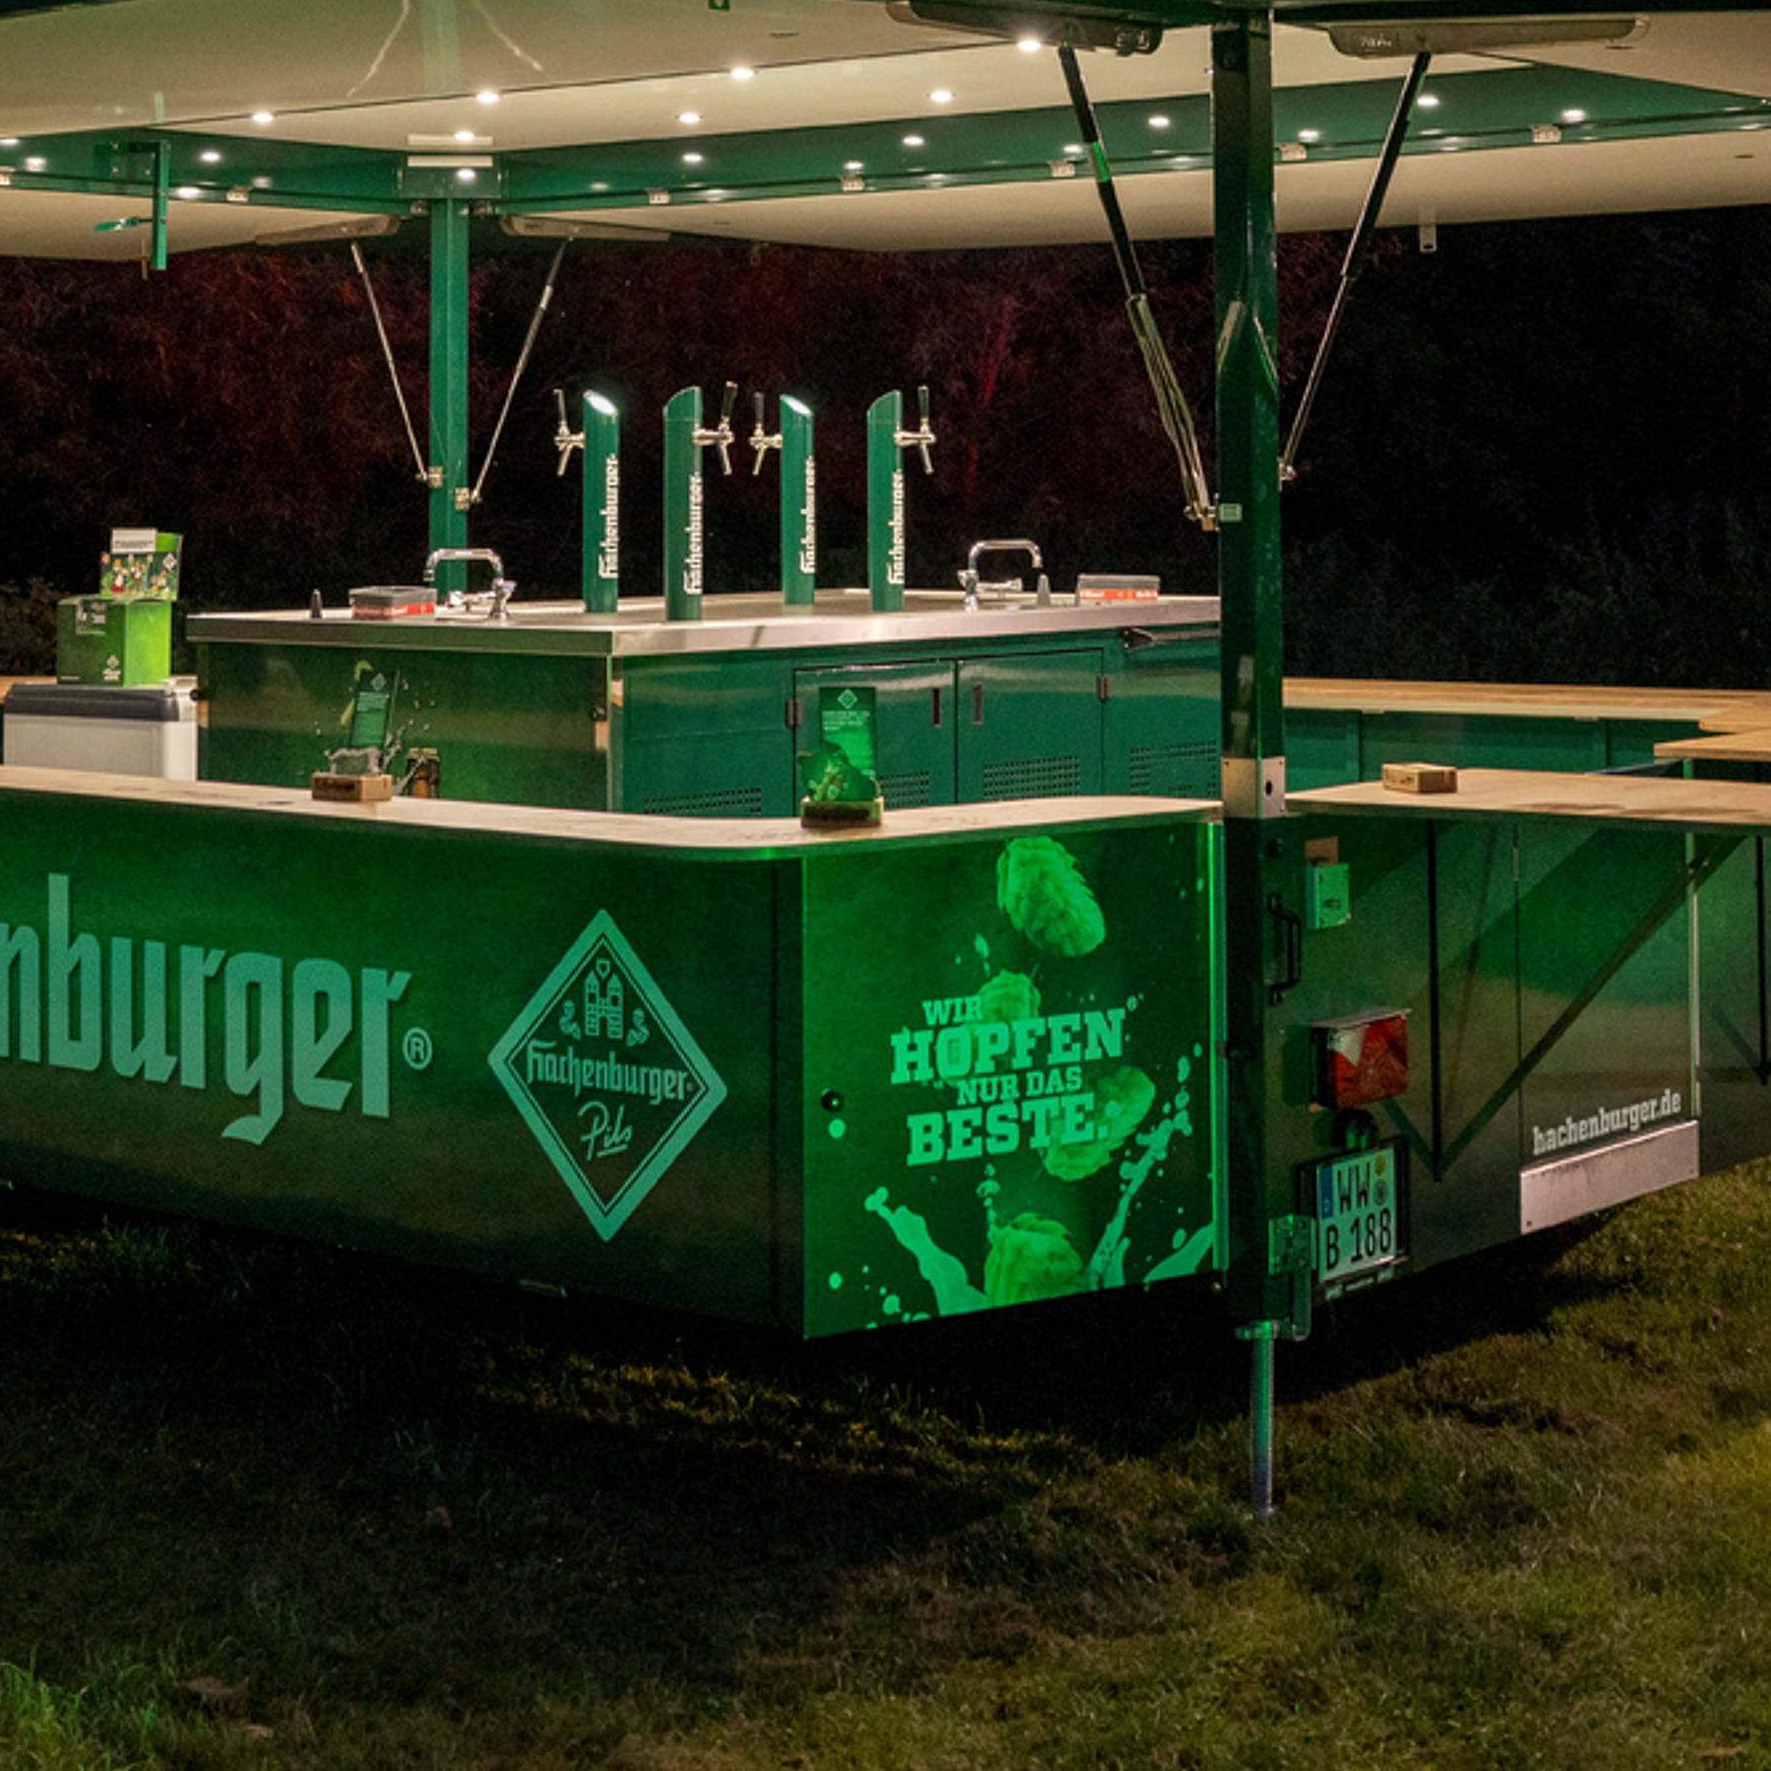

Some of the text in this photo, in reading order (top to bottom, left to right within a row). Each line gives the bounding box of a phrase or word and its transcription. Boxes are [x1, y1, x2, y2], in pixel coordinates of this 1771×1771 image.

[922, 995, 984, 1026] WIR
[527, 1039, 694, 1105] Hachenburger
[891, 1008, 1126, 1085] HOPFEN
[957, 1065, 1082, 1105] NUR DAS
[578, 1101, 633, 1161] Pils
[906, 1092, 1109, 1166] BESTE.
[1533, 1088, 1682, 1156] hachenburger.de
[1337, 1161, 1371, 1214] WW
[1326, 1207, 1392, 1270] B 188
